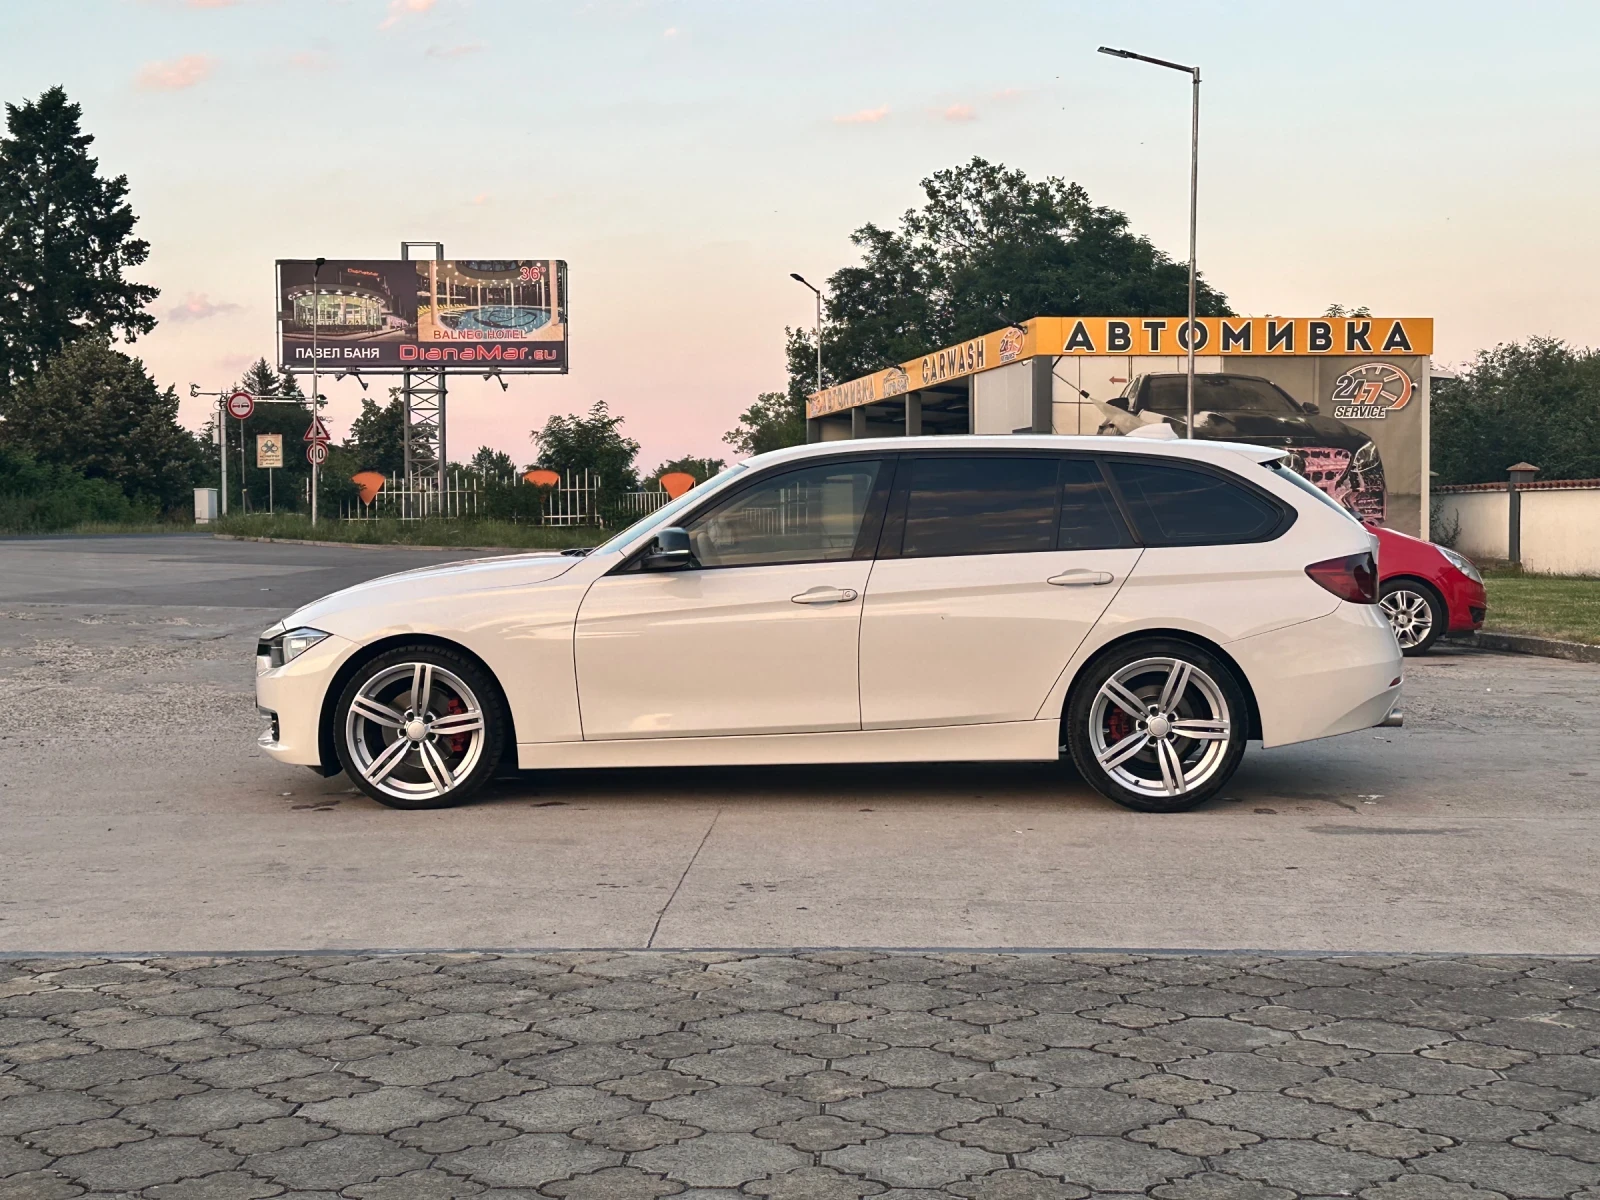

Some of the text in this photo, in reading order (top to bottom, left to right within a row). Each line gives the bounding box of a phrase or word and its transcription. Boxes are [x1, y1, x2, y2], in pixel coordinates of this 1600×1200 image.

[433, 329, 527, 340] BALNEO HOTEL
[1063, 319, 1414, 353] АВТОМИВКА
[295, 347, 380, 359] ПАВЕЛ БАНЯ
[922, 337, 986, 385] CARWASH
[1334, 405, 1386, 419] SERVICE
